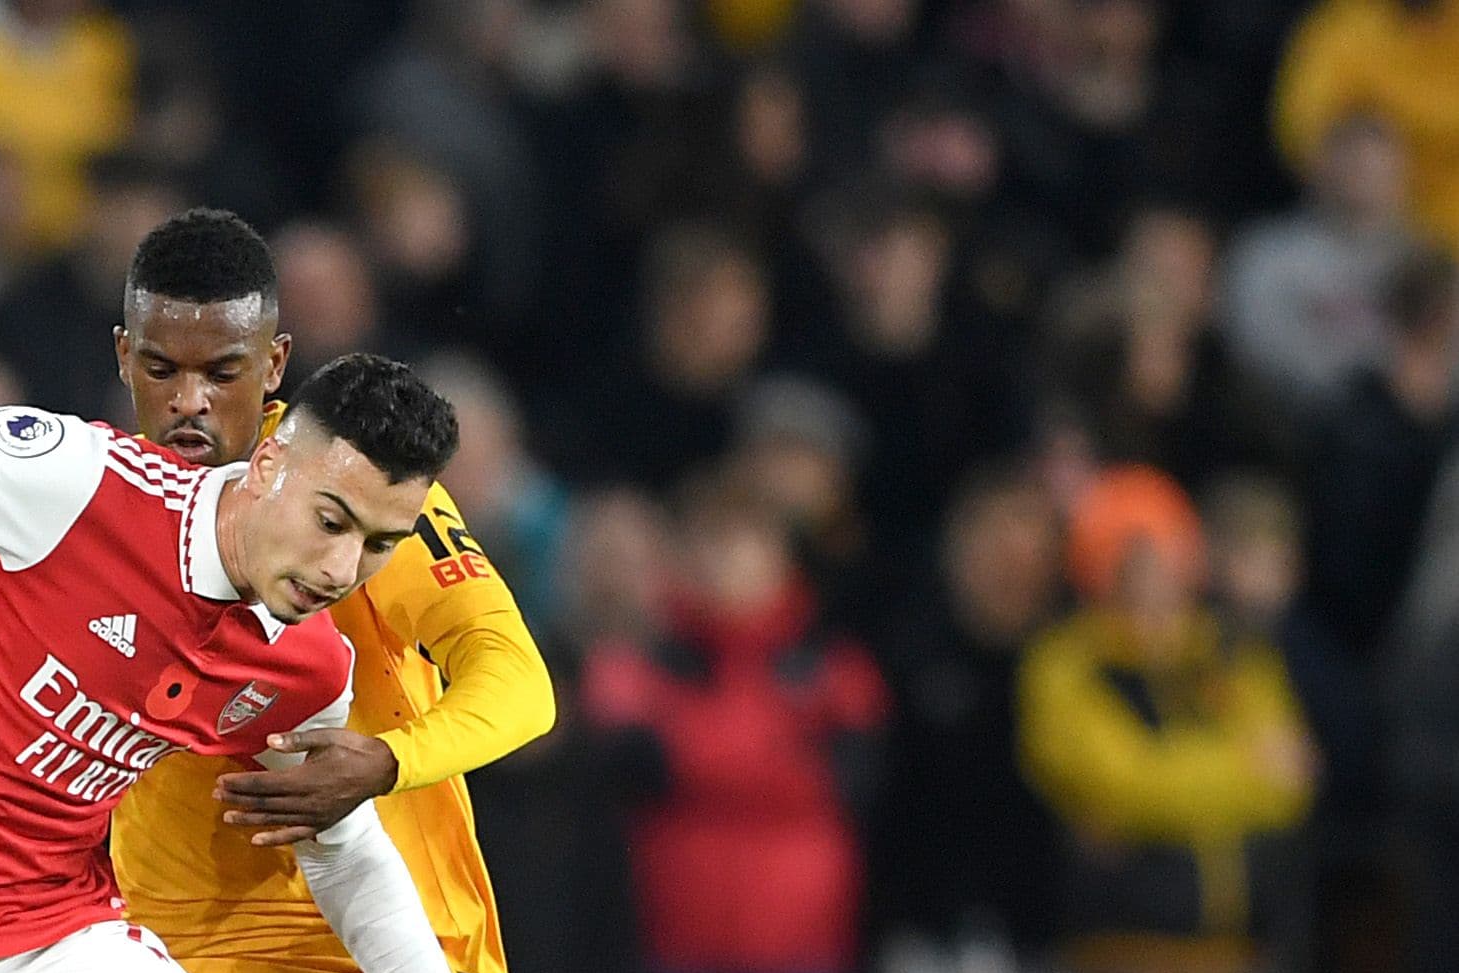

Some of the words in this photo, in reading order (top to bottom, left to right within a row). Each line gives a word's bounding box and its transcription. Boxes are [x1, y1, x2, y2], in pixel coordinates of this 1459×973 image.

[430, 554, 490, 589] BE
[88, 619, 136, 658] adidas
[19, 653, 188, 770] Emira
[15, 731, 84, 784] FLY
[66, 759, 139, 801] BETT
